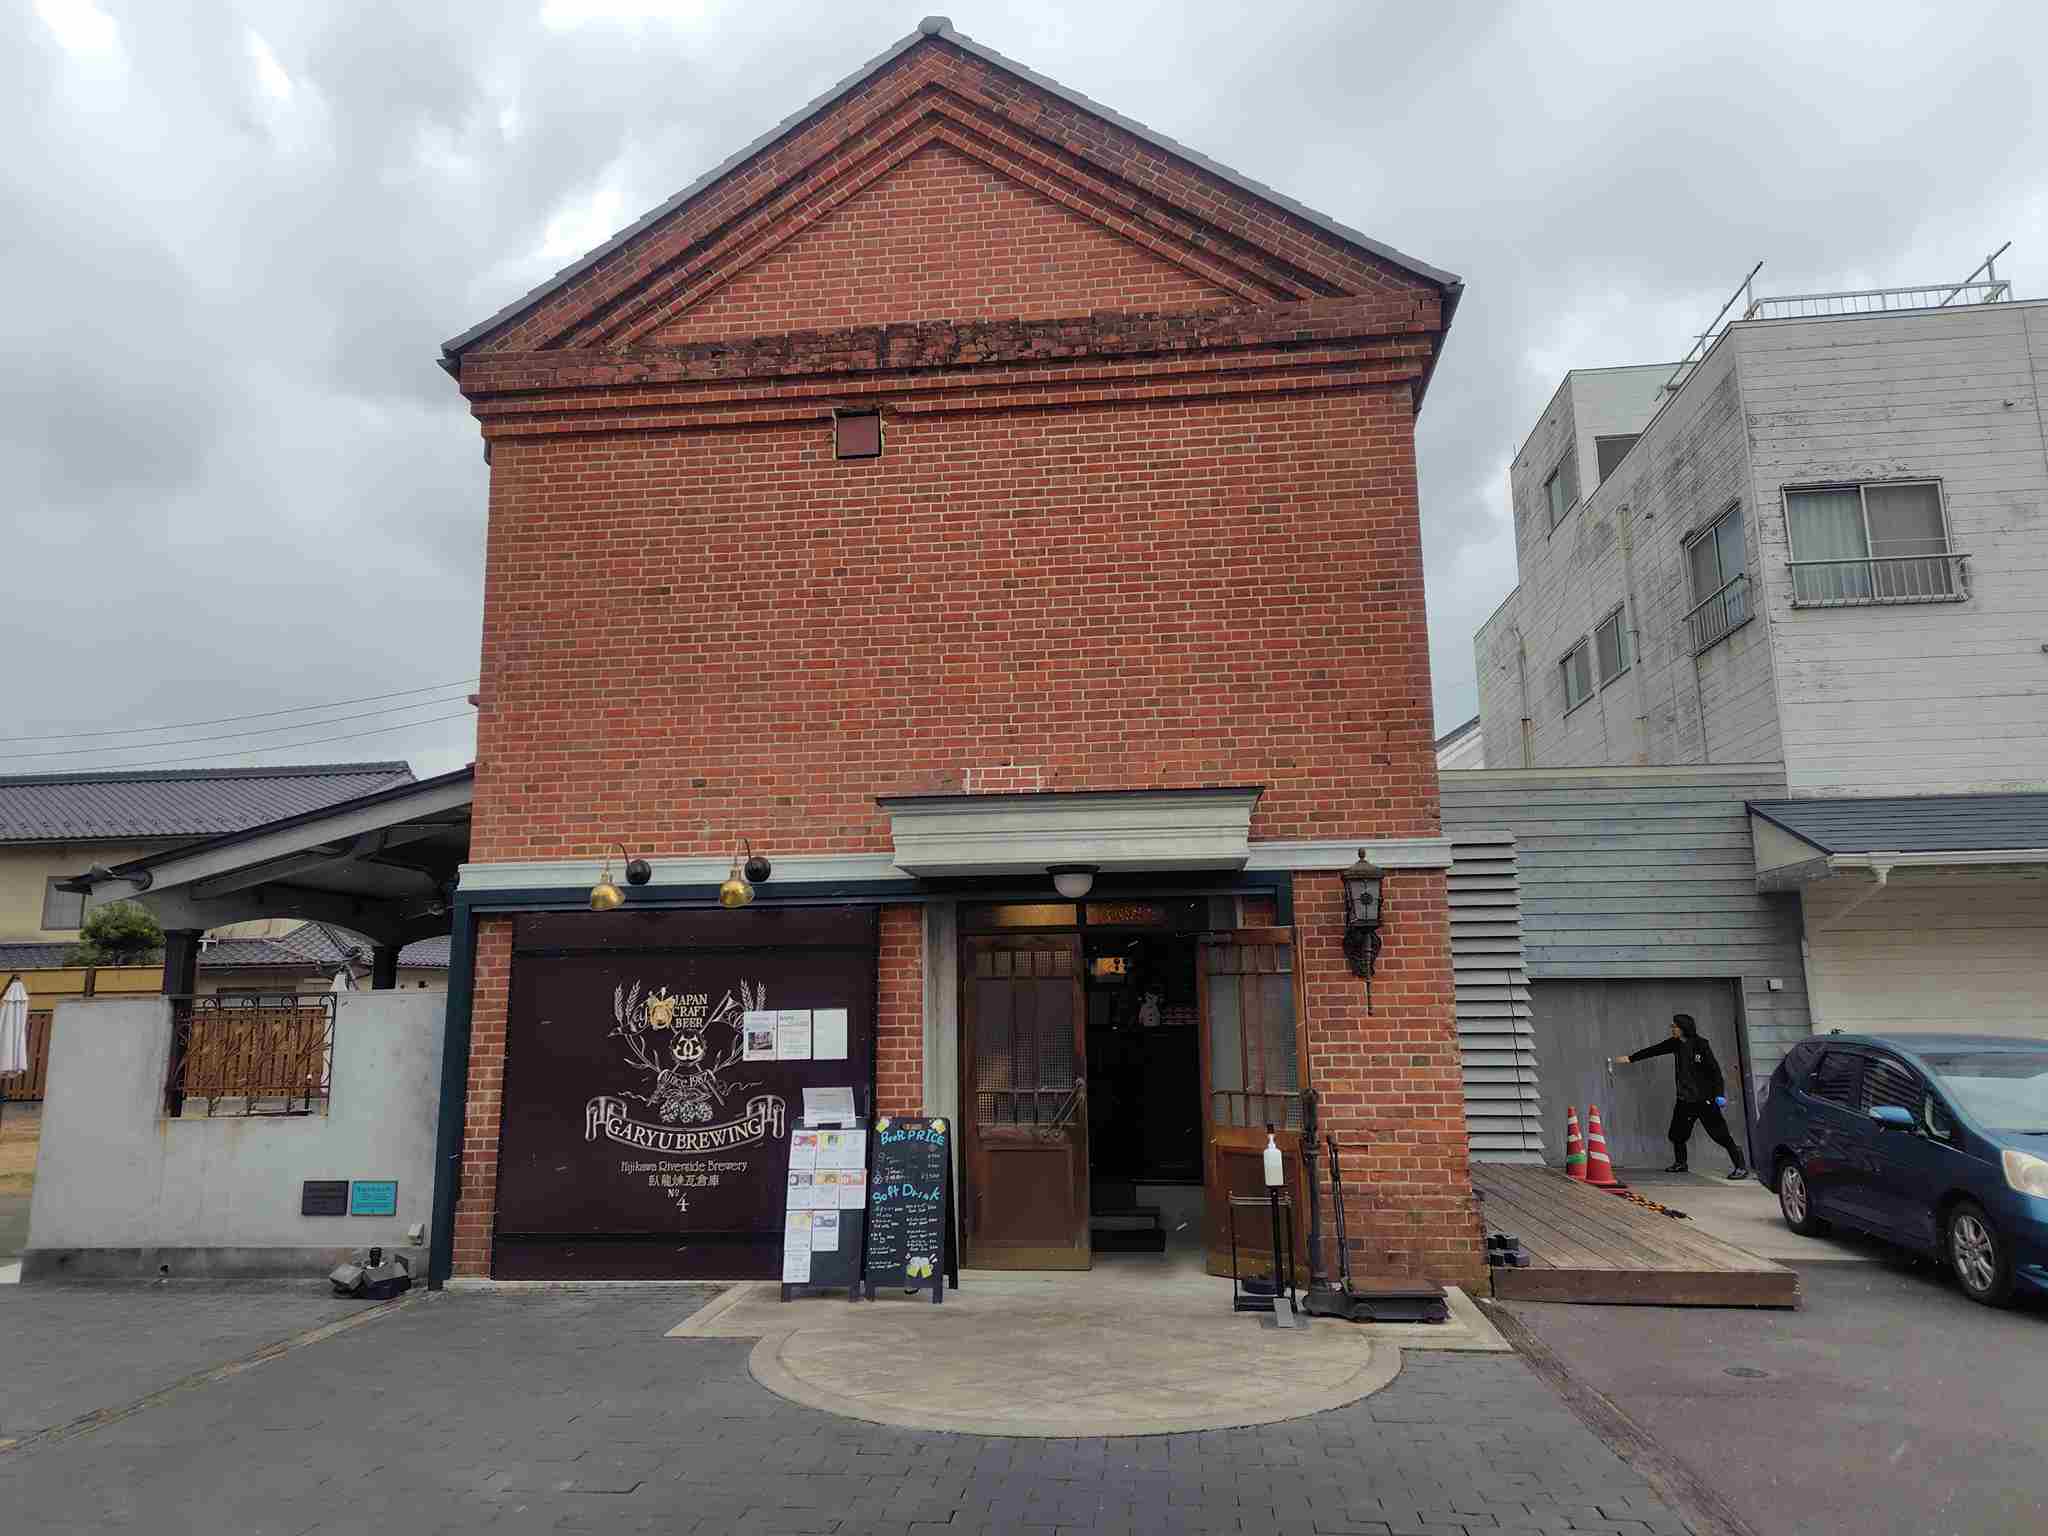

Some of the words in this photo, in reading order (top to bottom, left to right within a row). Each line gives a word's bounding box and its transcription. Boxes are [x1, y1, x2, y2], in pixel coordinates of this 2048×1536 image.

[674, 993, 708, 1006] JAPAN
[672, 1006, 709, 1017] CRAFT
[675, 1017, 703, 1028] BEER
[607, 1117, 673, 1149] GARYU
[674, 1117, 762, 1151] BREWING
[658, 1160, 705, 1172] Riverside
[707, 1159, 748, 1173] Brewery
[675, 1192, 690, 1212] 4
